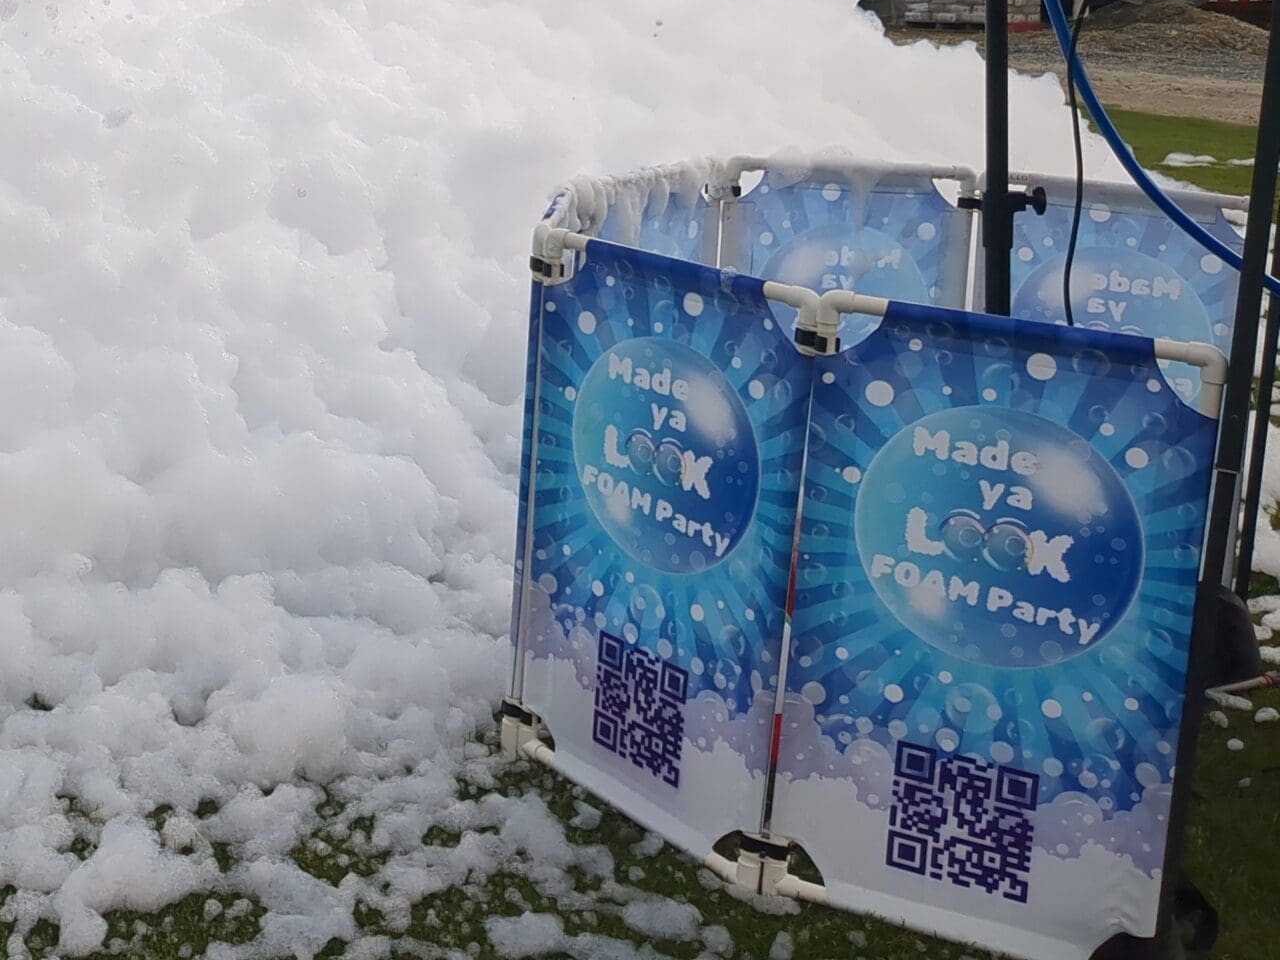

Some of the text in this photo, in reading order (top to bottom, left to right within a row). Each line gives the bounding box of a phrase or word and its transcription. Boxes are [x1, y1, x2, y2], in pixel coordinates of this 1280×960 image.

[608, 353, 689, 400] Made
[651, 403, 686, 432] ya
[604, 424, 713, 499] LOOK
[913, 426, 1039, 476] Made
[582, 464, 730, 557] FOAM Party
[979, 480, 1033, 510] ya
[905, 507, 1074, 583] LOOK
[871, 554, 1100, 644] FOAM Party
